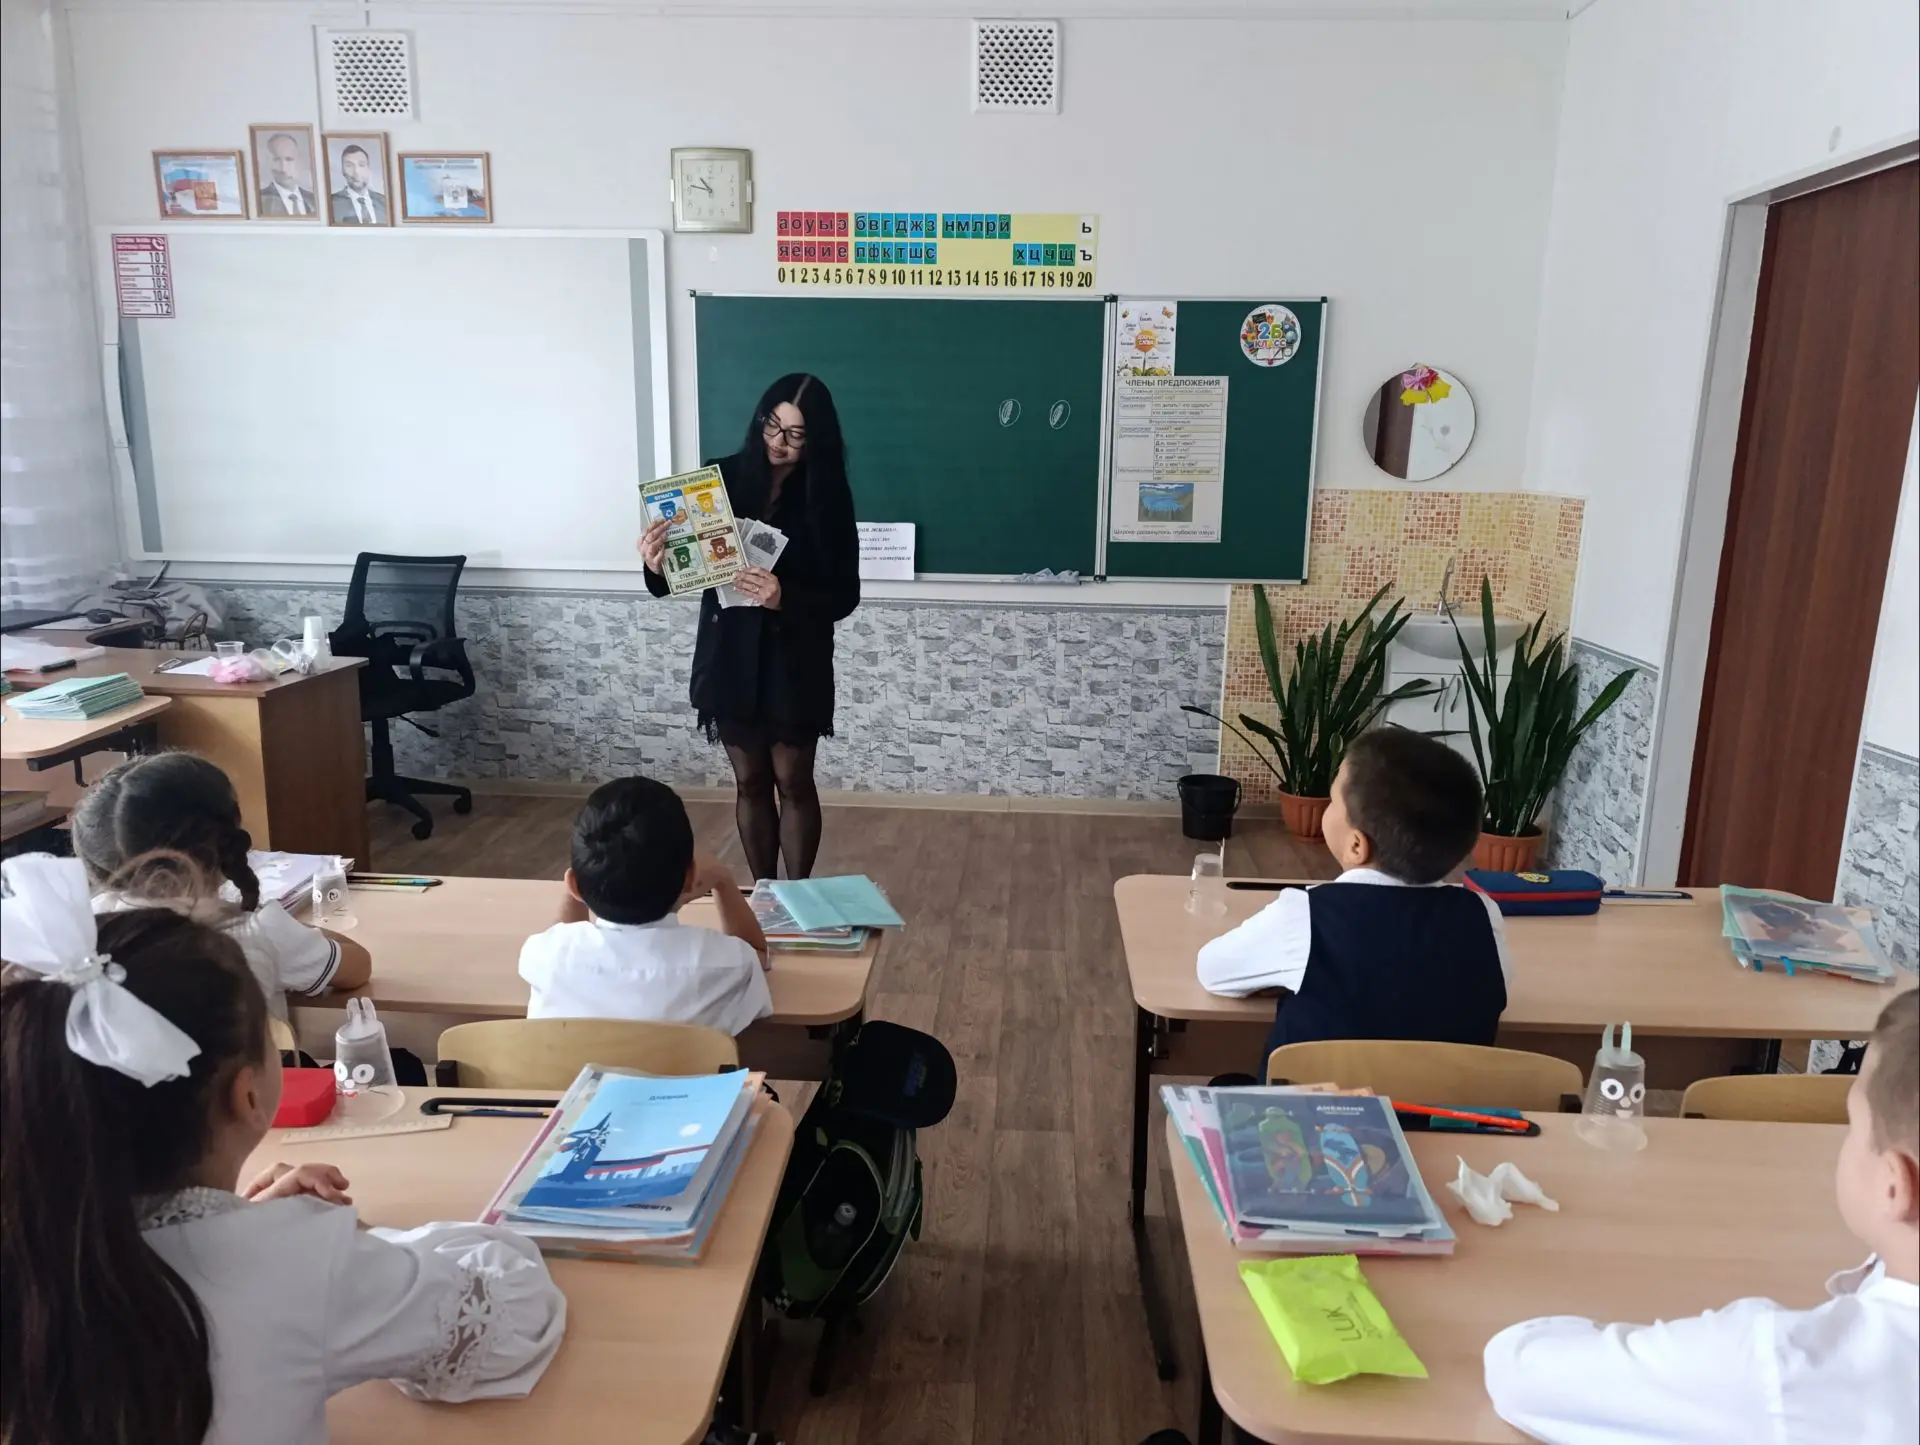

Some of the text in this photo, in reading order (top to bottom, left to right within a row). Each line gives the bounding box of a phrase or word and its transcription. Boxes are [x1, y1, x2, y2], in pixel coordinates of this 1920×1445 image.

[149, 252, 166, 263] 101
[150, 265, 168, 276] 102
[778, 267, 1093, 287] 0 1 2 3 4 5 6 7 8 9 10 11 12 13 14 15 16 17 18 19 20
[152, 277, 168, 289] 103
[153, 290, 169, 301] 104
[154, 303, 171, 314] 112
[1254, 339, 1287, 349] КЛАСС
[1125, 379, 1221, 388] ЧЛЕНЫ ПРЕДЛОЖЕНИЯ
[700, 518, 723, 528] ПЛАСТИК
[702, 528, 728, 538] ОРГАНИКА
[669, 538, 688, 547] СТЕКЛО
[713, 561, 738, 570] ОРГАНИКА
[680, 570, 698, 579] СТЕКЛО
